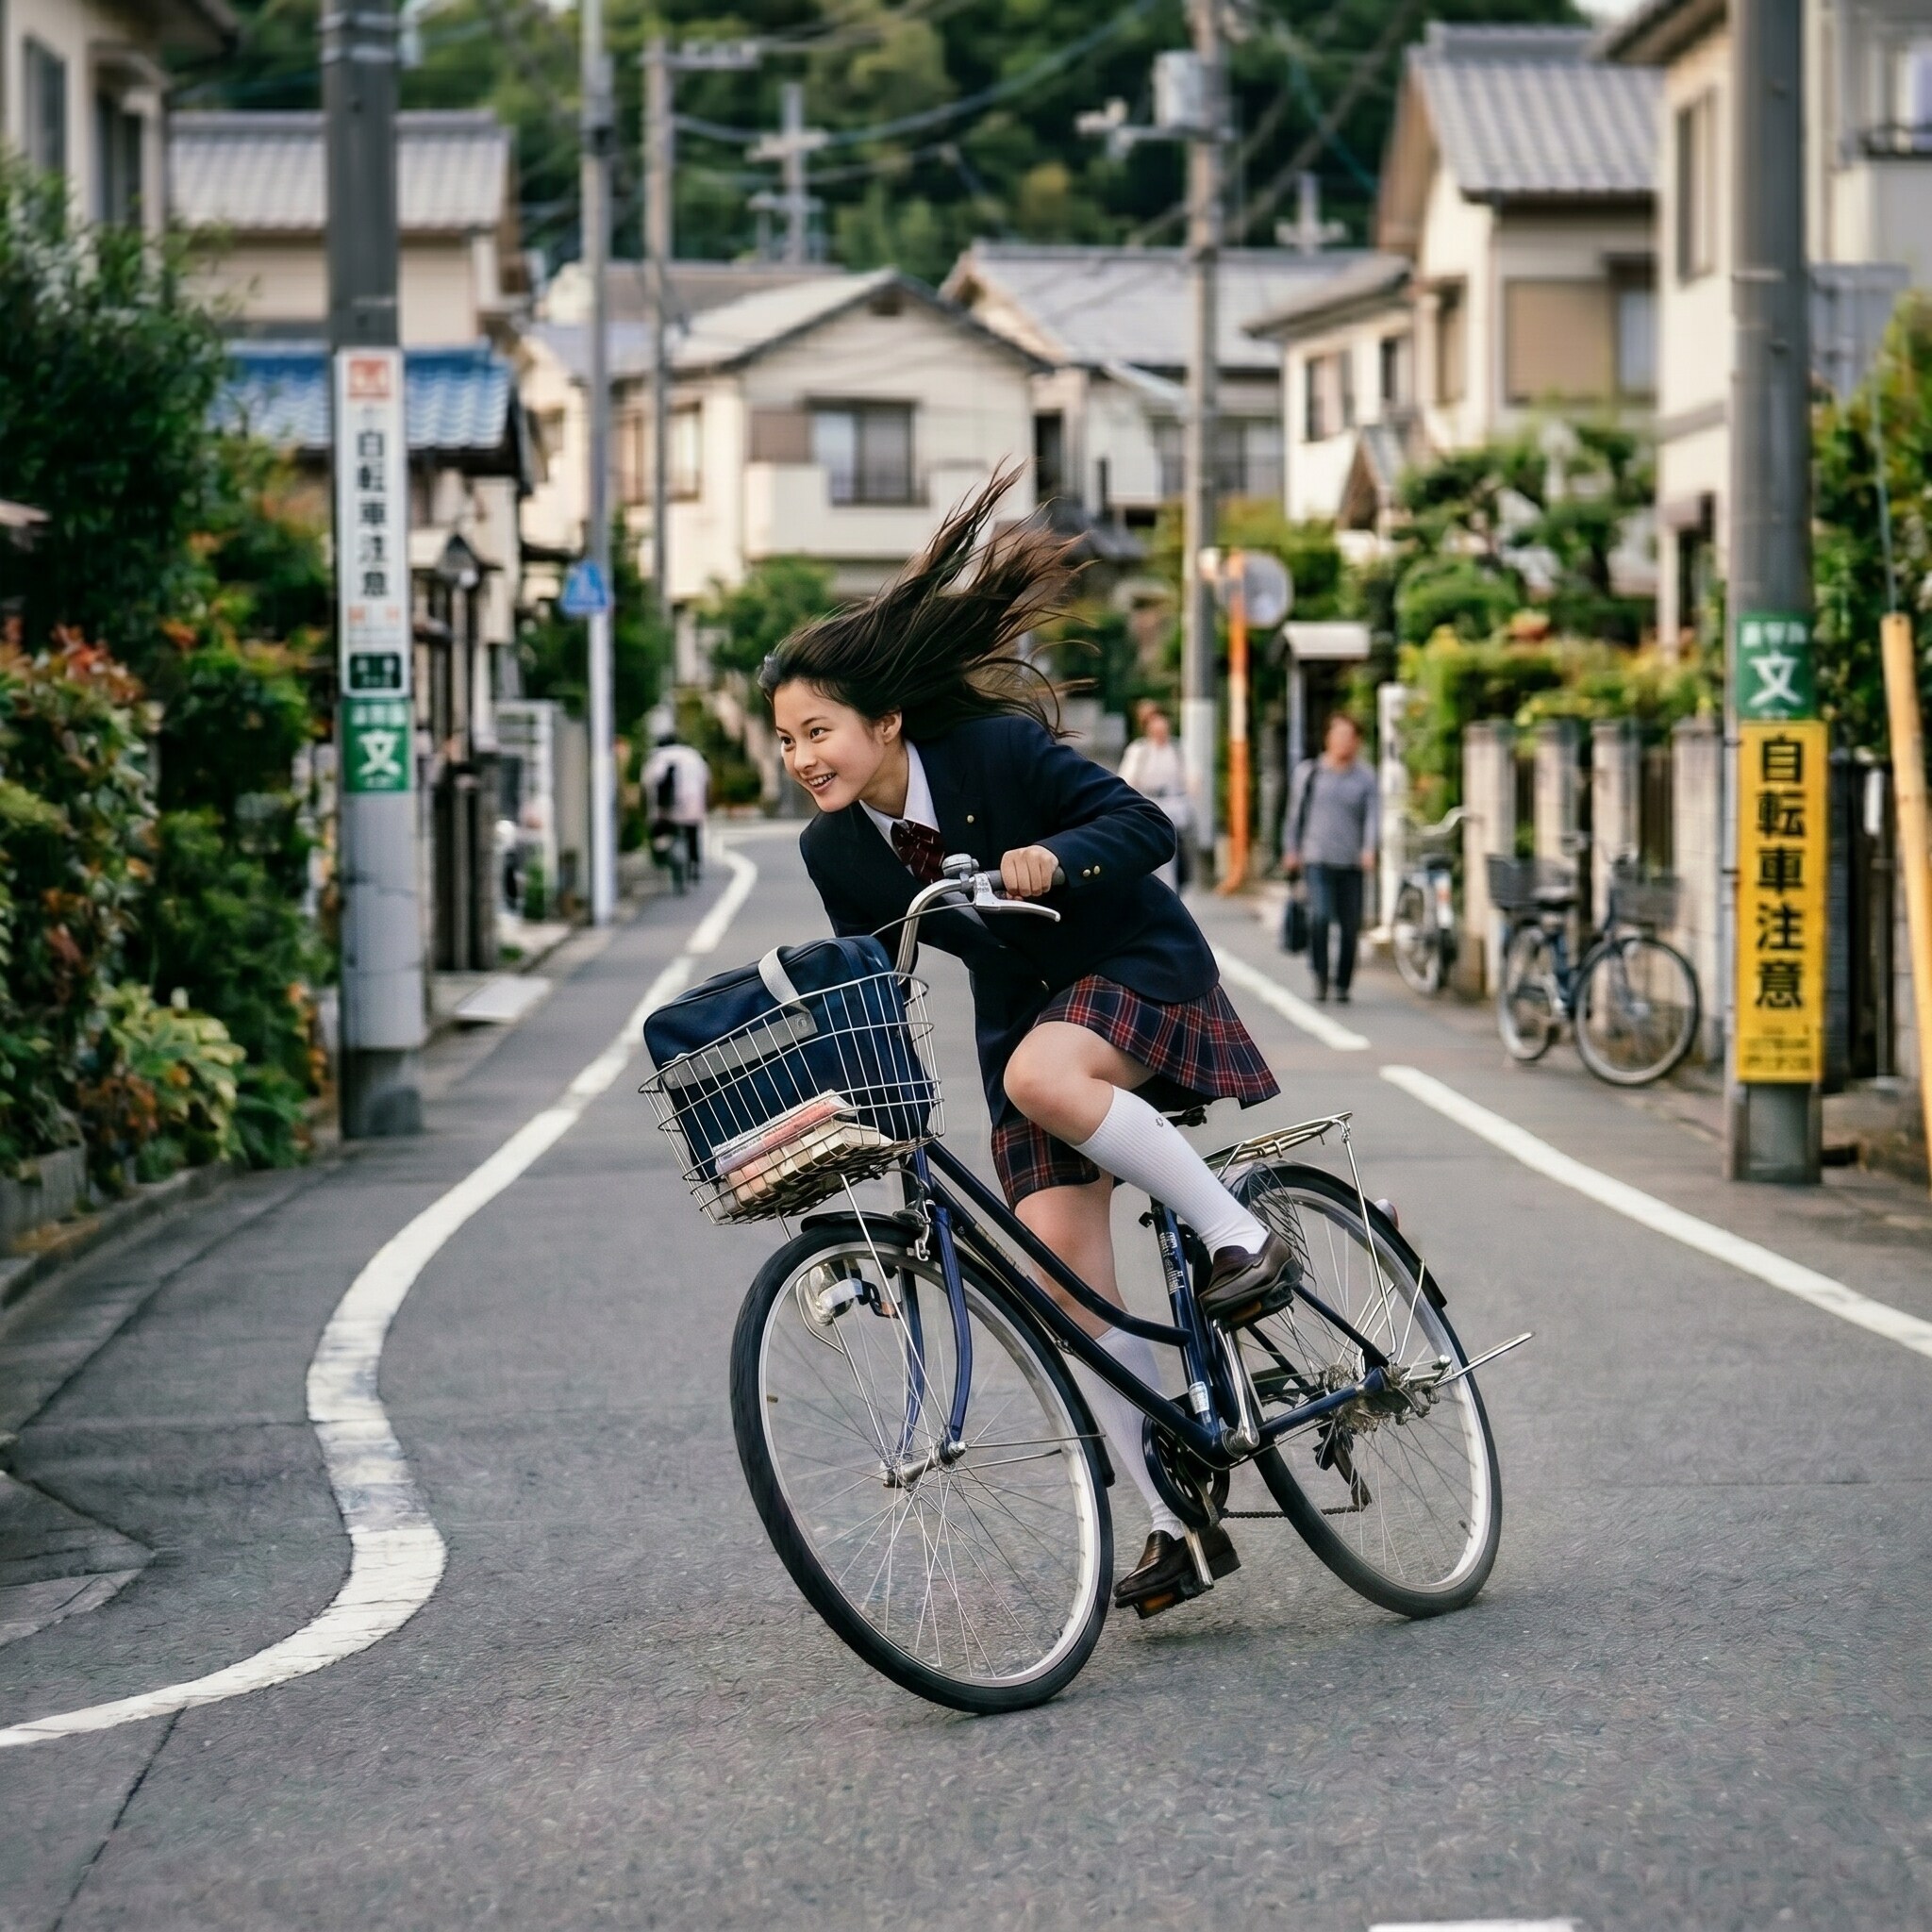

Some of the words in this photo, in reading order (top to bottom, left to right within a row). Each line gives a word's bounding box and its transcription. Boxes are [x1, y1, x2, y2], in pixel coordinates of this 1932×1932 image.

[1749, 649, 1803, 708] 文
[357, 729, 403, 776] 文
[1756, 733, 1807, 1008] 自転車注意
